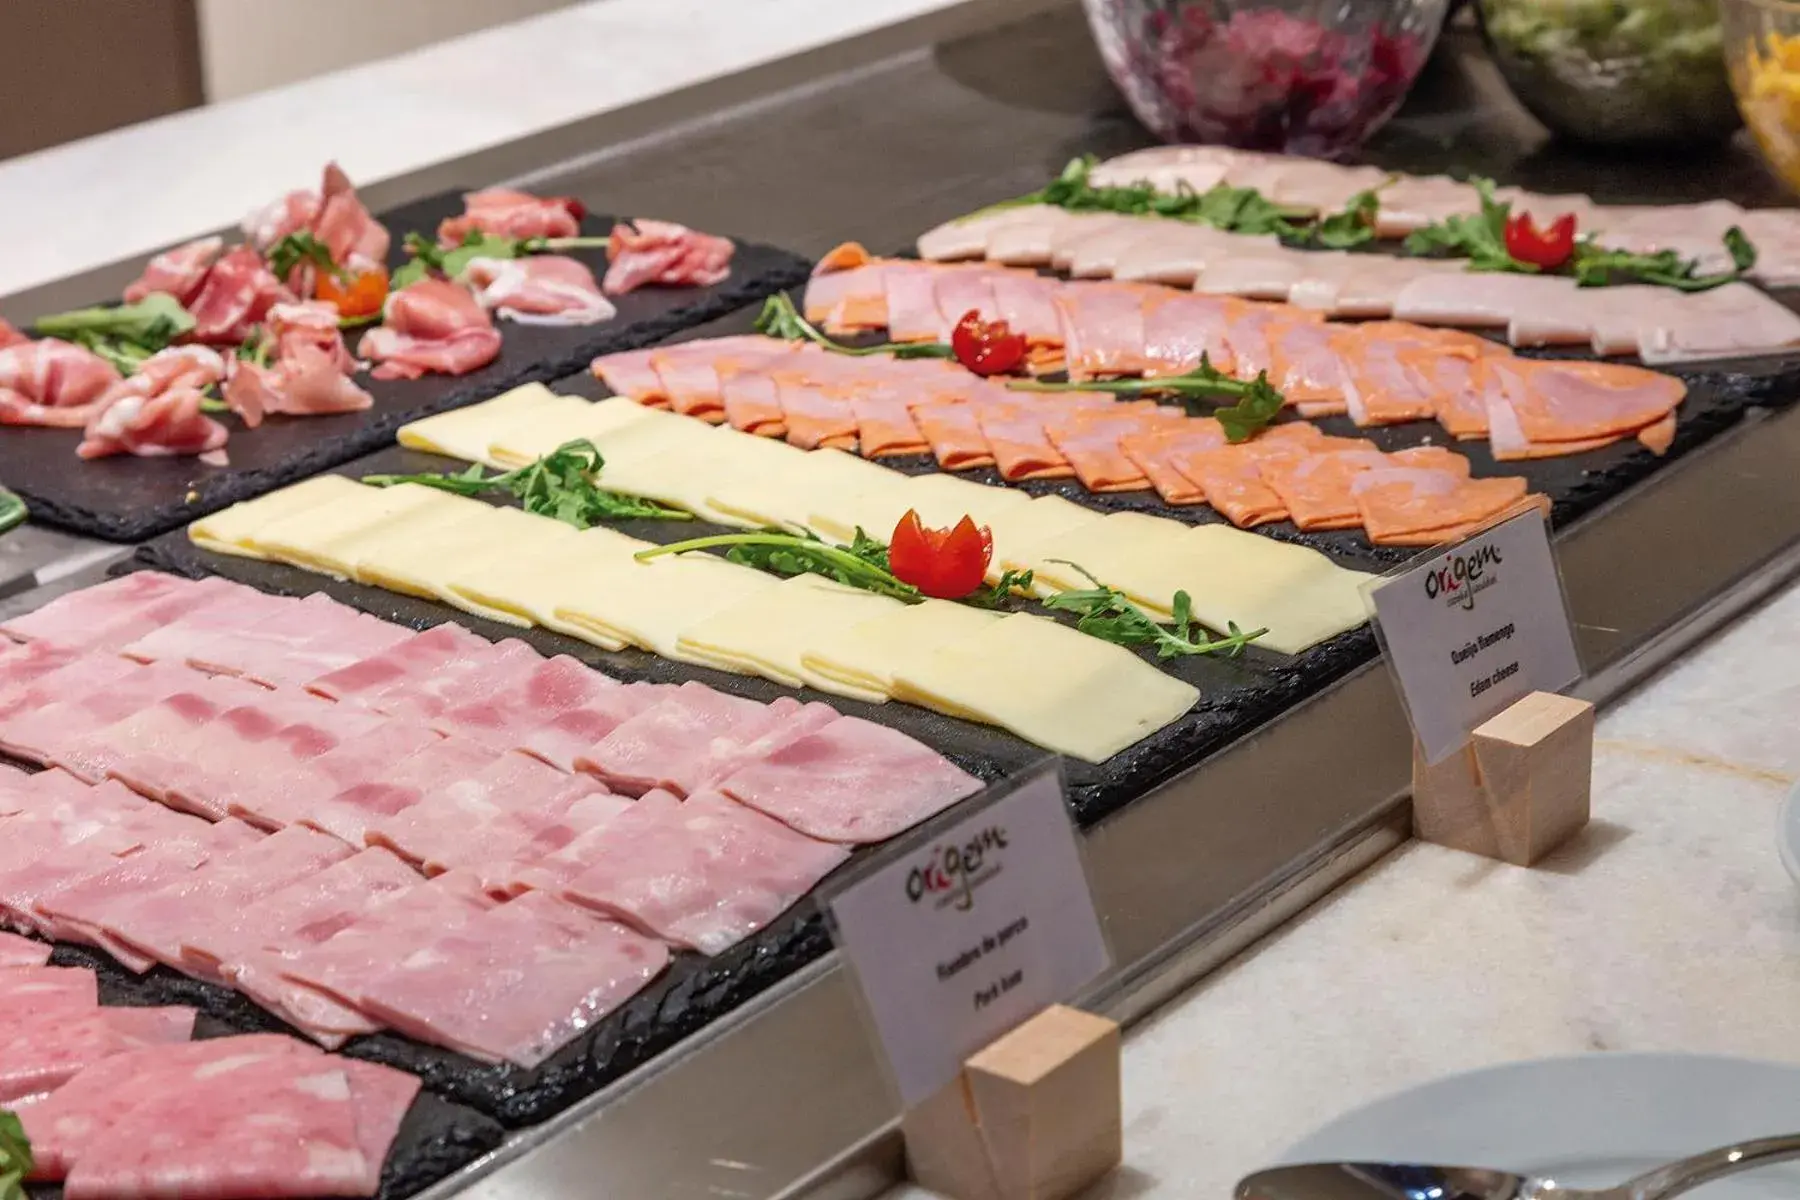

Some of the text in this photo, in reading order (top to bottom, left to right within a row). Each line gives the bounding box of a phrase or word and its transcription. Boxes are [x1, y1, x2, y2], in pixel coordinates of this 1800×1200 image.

[1425, 544, 1502, 610] origem
[1451, 642, 1479, 665] Queijo
[1492, 661, 1519, 685] cheese
[906, 826, 1008, 911] origem
